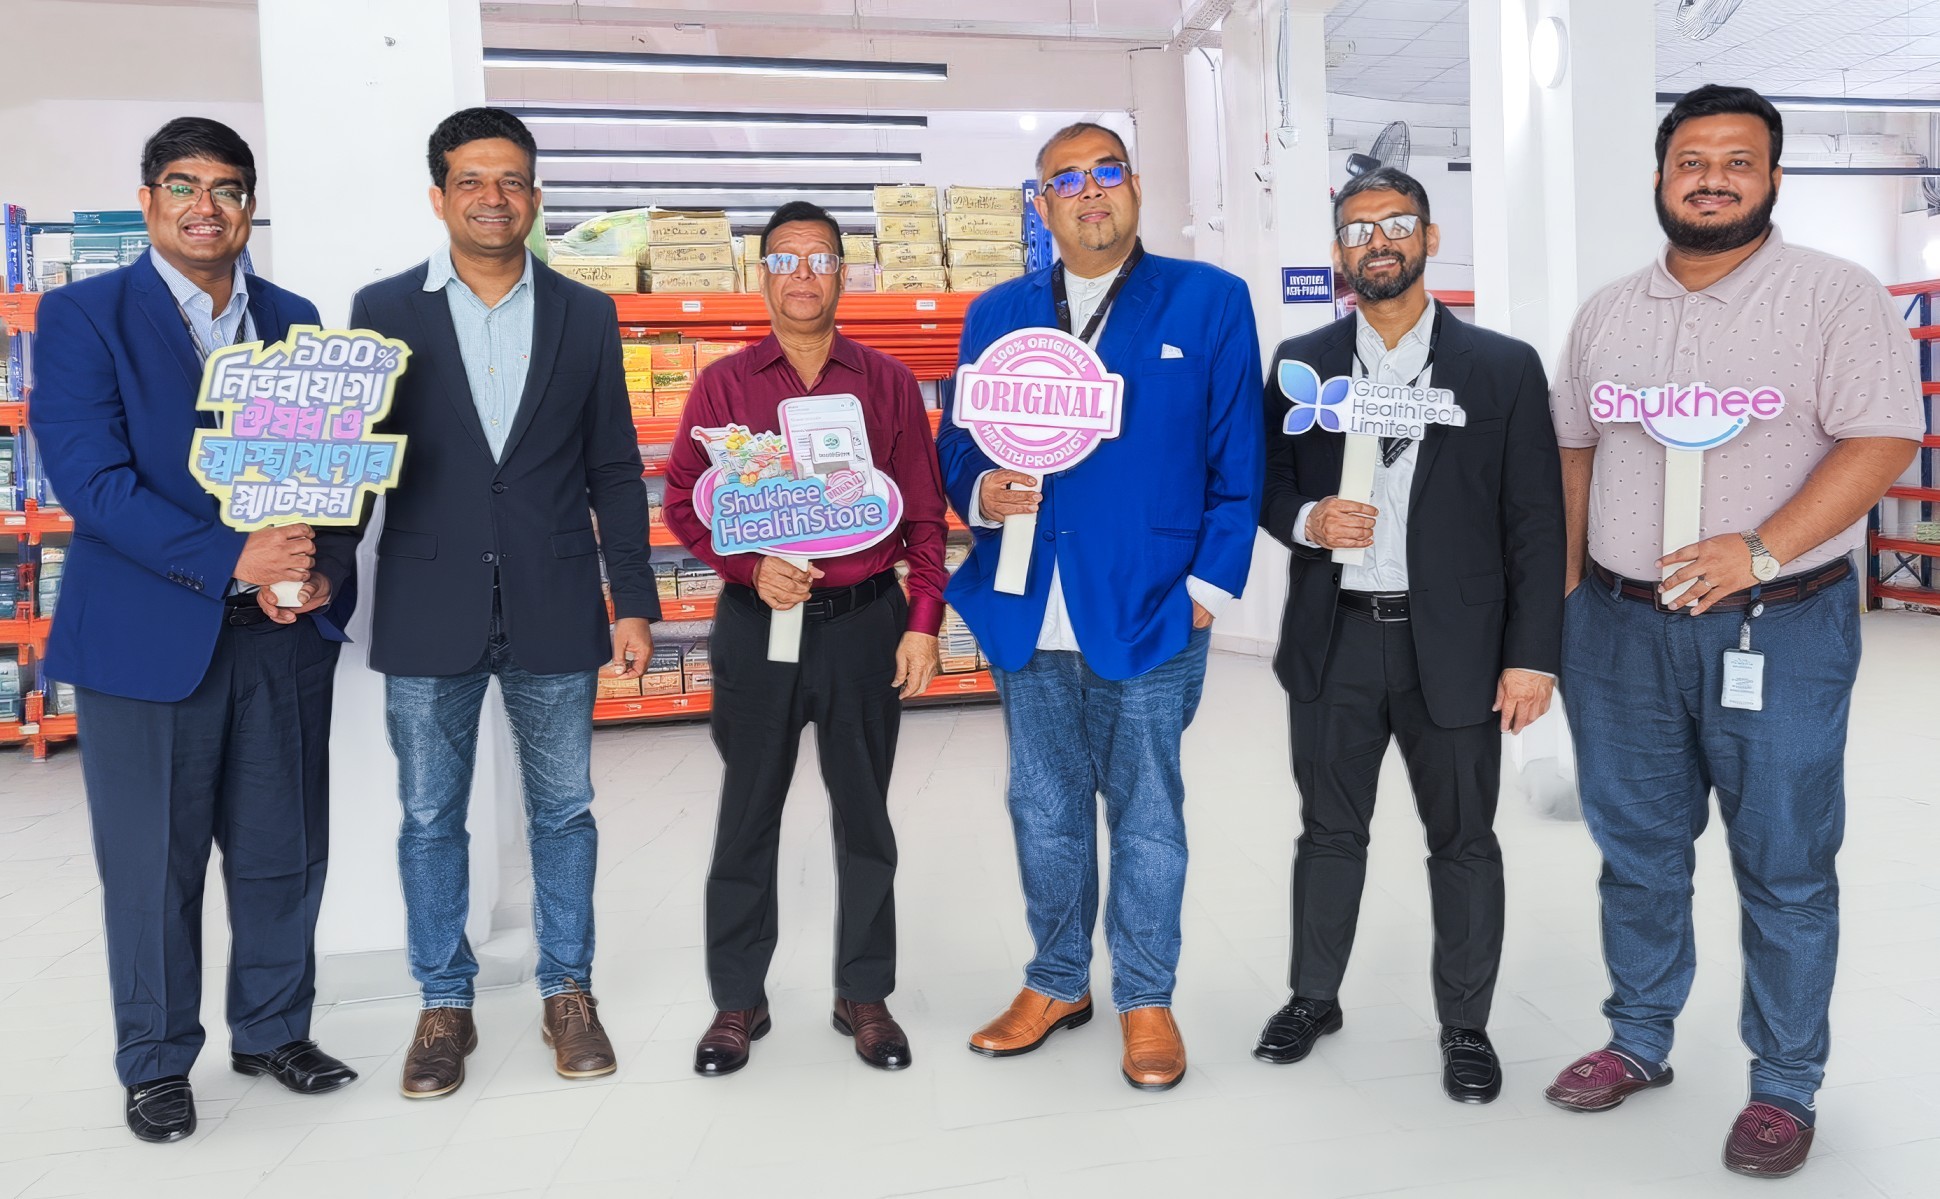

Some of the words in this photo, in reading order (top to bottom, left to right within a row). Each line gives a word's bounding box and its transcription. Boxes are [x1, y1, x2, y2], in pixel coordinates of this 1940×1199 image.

[293, 335, 401, 369] ১০০%
[990, 340, 1026, 367] 100%
[1027, 337, 1090, 372] ORIGINAL
[970, 379, 1108, 419] ORIGINAL
[1353, 380, 1453, 404] Grameen
[1593, 384, 1782, 420] Shukhee
[233, 395, 325, 440] ঔষধ
[332, 409, 364, 440] ও
[1350, 416, 1422, 439] Limited
[1352, 399, 1465, 426] HealthTech
[980, 424, 1023, 465] HEALTH
[1025, 431, 1089, 467] PRODUCT
[719, 484, 822, 517] Shukhee
[718, 502, 882, 547] HealthStore
